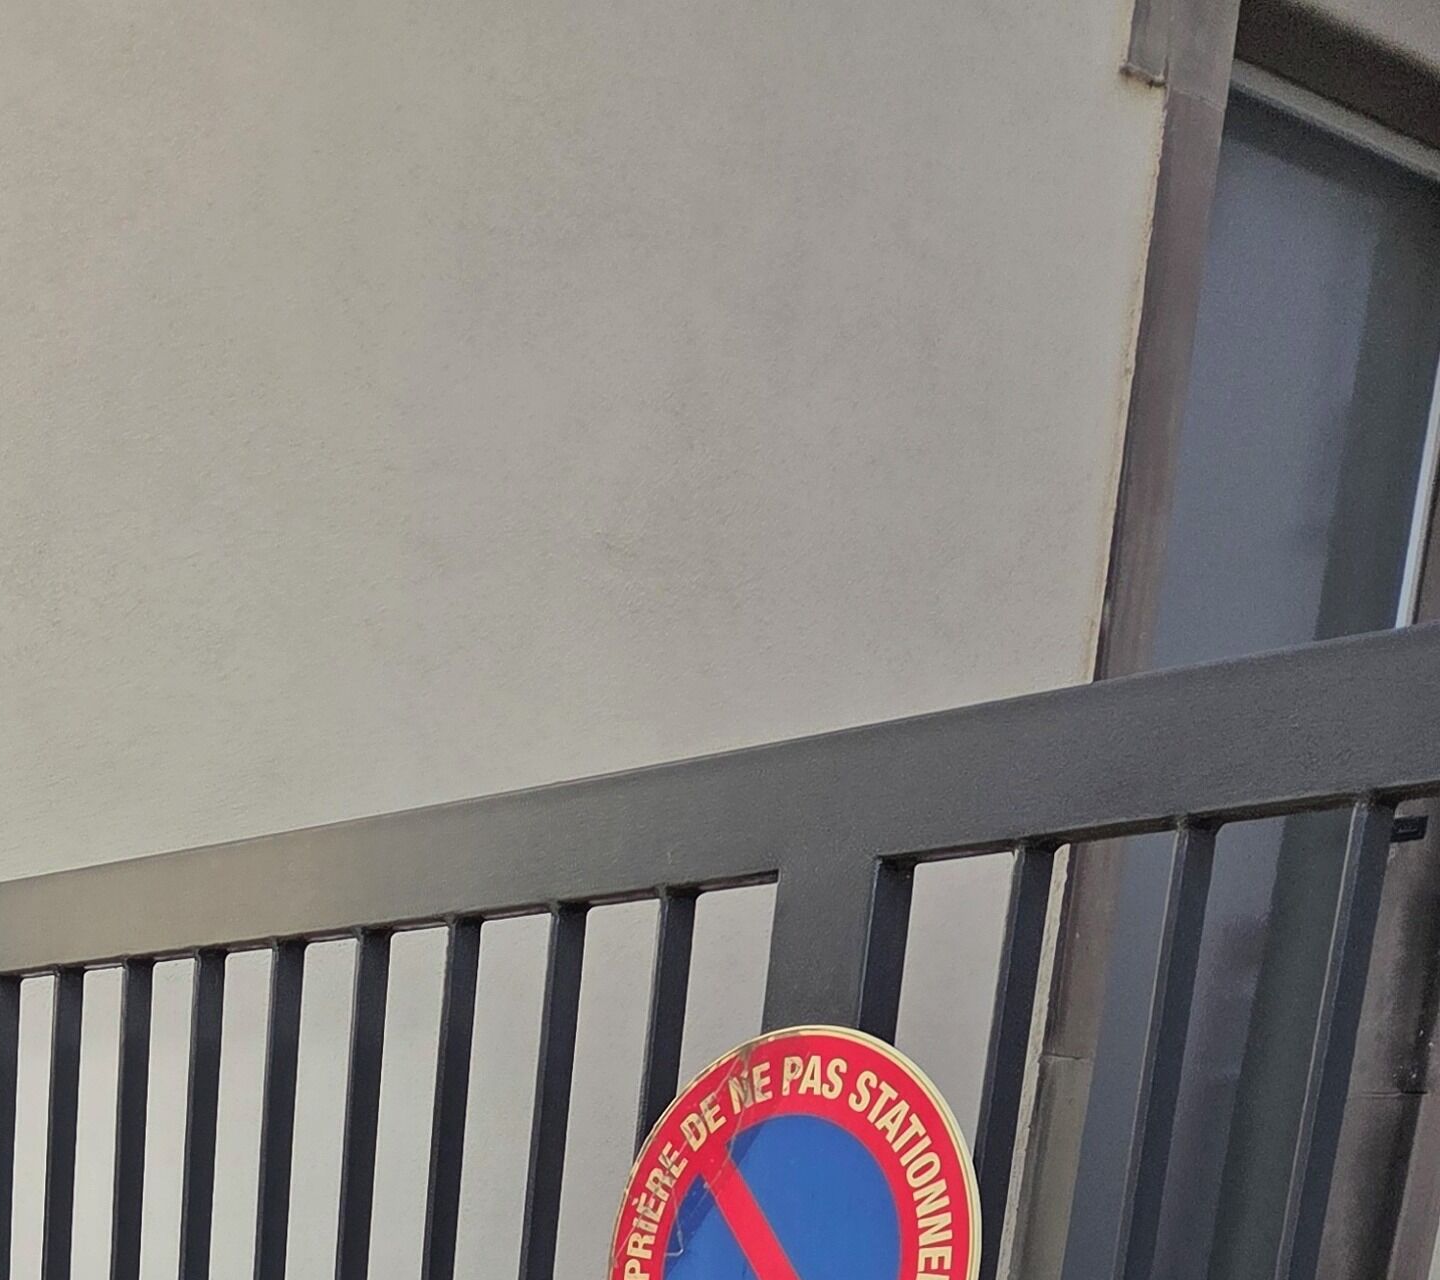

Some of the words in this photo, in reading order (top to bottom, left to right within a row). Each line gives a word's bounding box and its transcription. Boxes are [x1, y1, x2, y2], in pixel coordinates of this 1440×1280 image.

[681, 1092, 728, 1152] DE
[728, 1061, 774, 1115] NE
[782, 1054, 848, 1100] PAS
